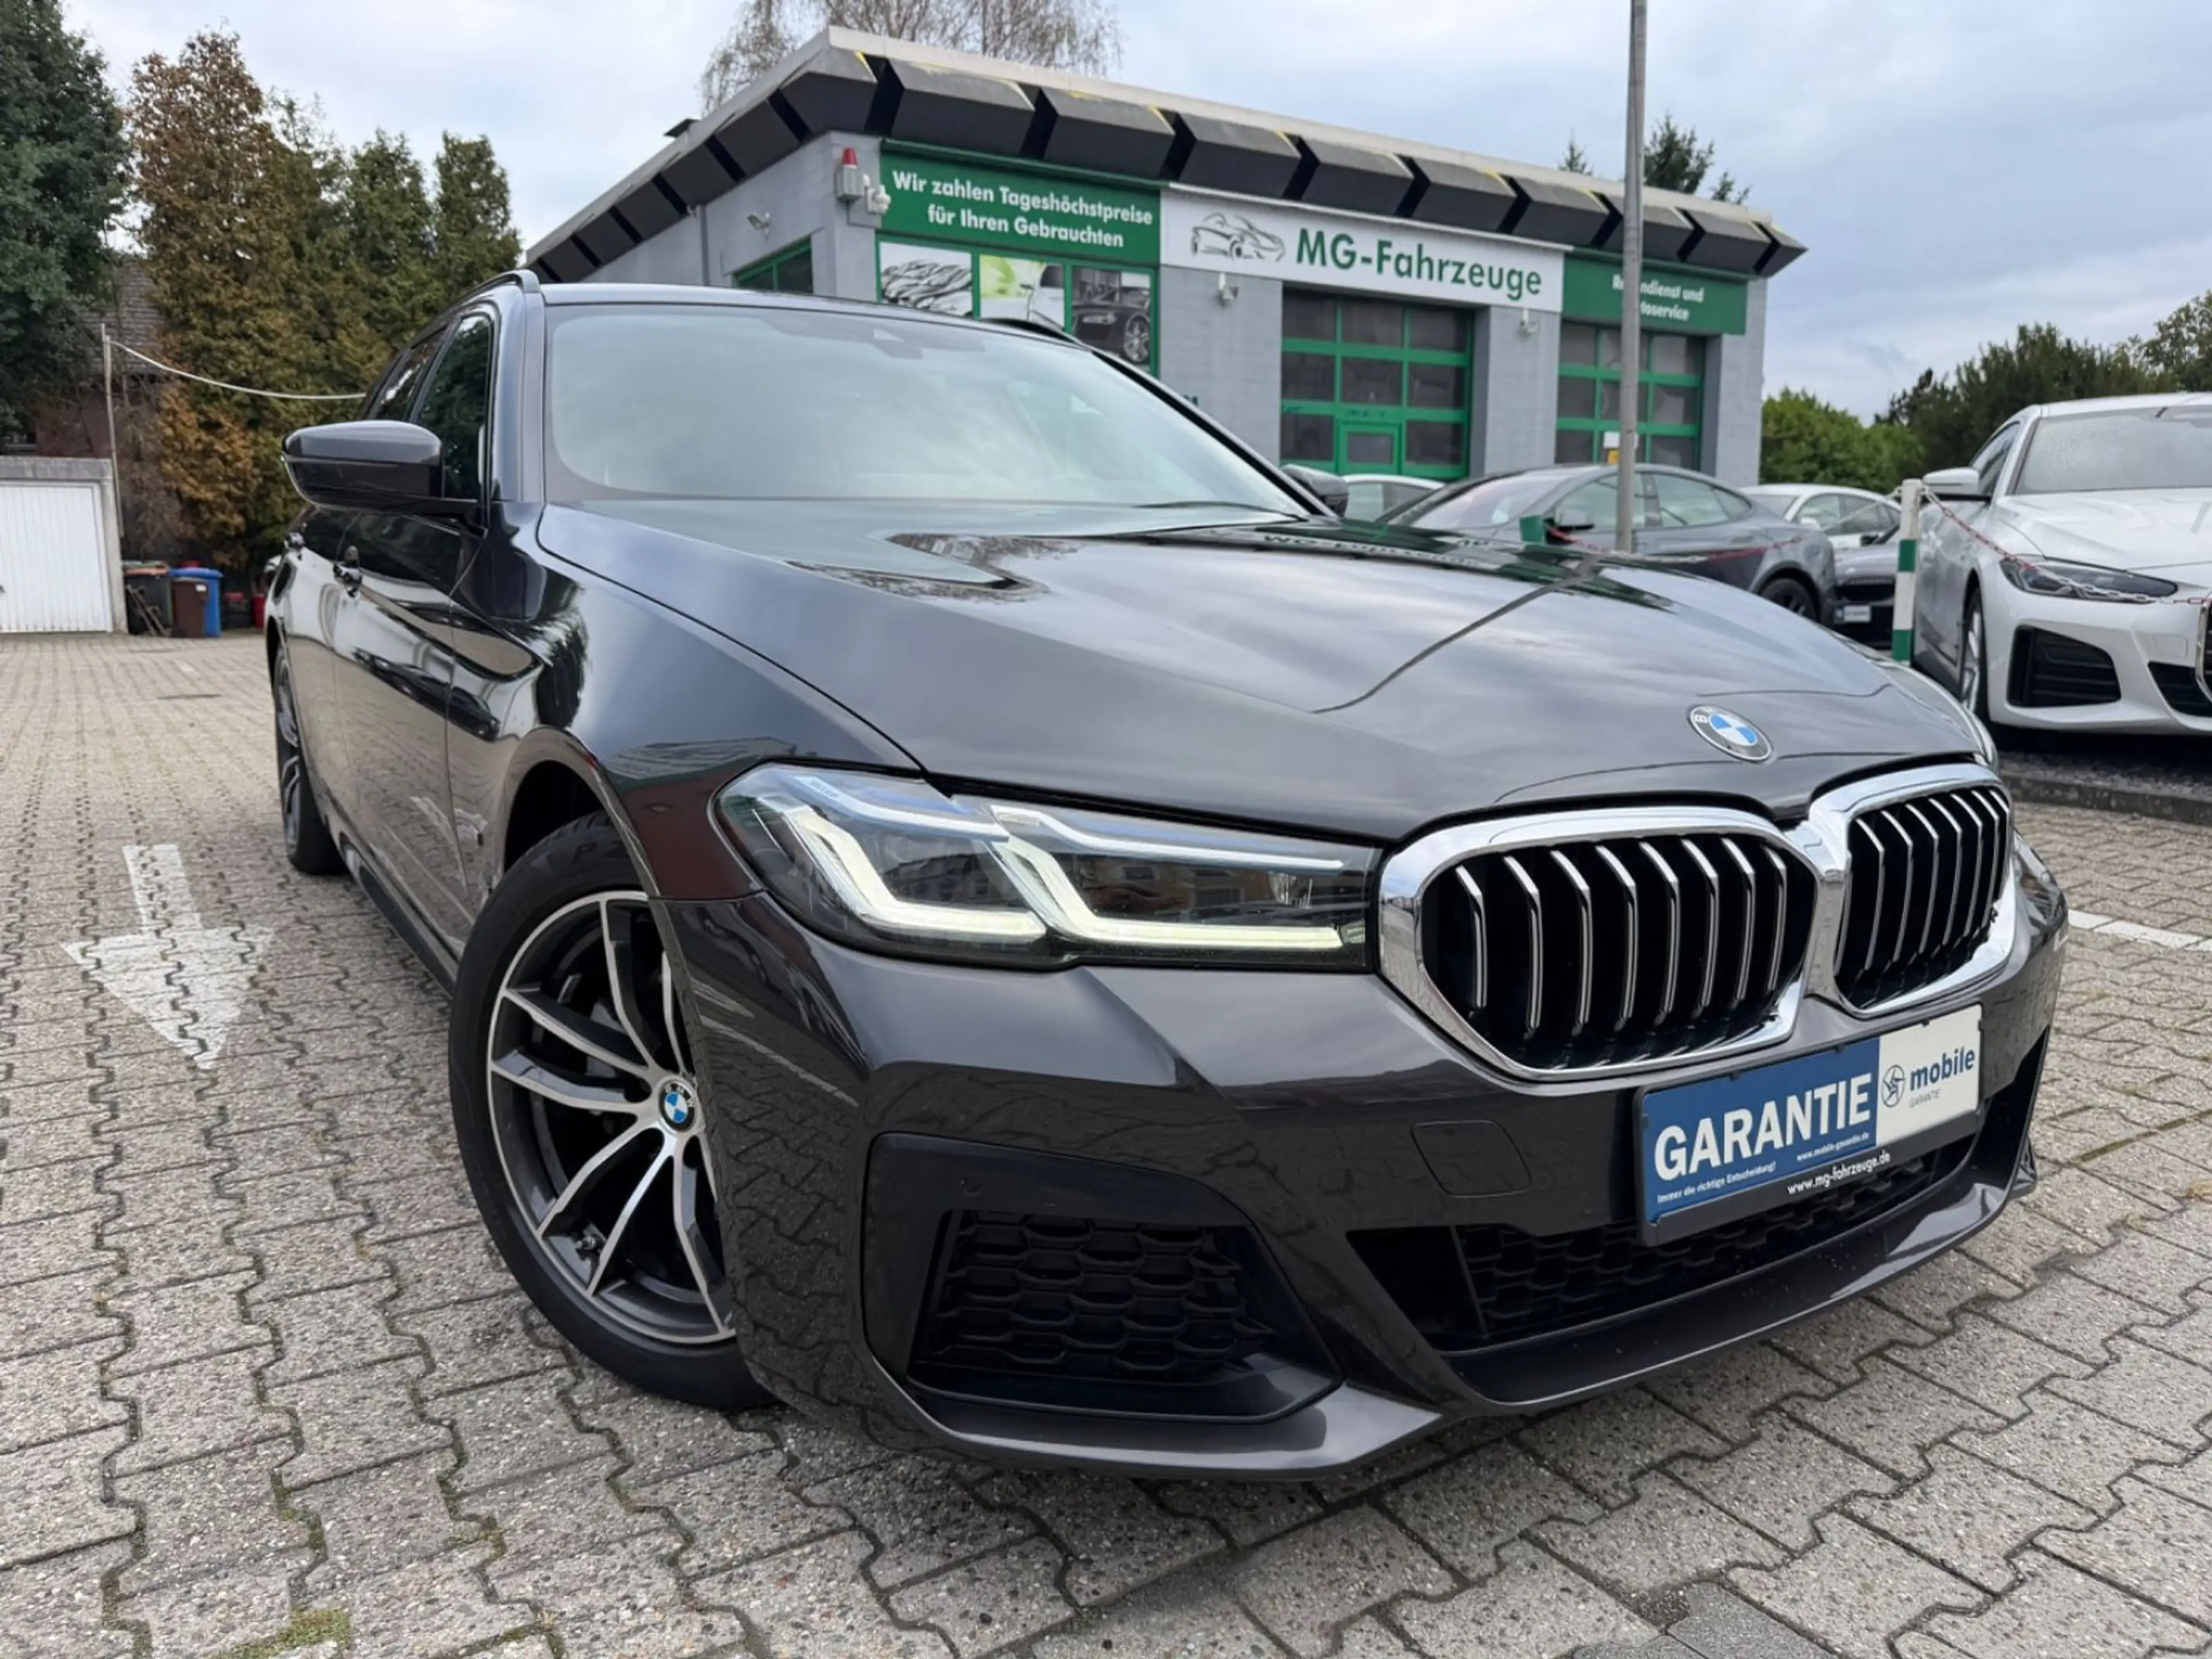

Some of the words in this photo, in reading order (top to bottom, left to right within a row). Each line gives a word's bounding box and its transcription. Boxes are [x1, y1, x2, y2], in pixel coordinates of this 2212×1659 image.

[892, 170, 927, 192] Wir
[931, 178, 994, 203] zahlen
[999, 185, 1153, 226] Tageshöchstpreise
[927, 203, 955, 225] für
[960, 209, 1009, 232] Ihren
[1013, 216, 1124, 248] Gebrauchten
[1296, 228, 1541, 301] MG-Fahrzeuge
[1683, 287, 1705, 303] und
[1910, 1046, 1975, 1092] mobile
[1654, 1073, 1872, 1181] GARANTIE
[1787, 1149, 1892, 1195] www.mg-fahrzeuge.de
[1657, 1190, 1683, 1204] Immer
